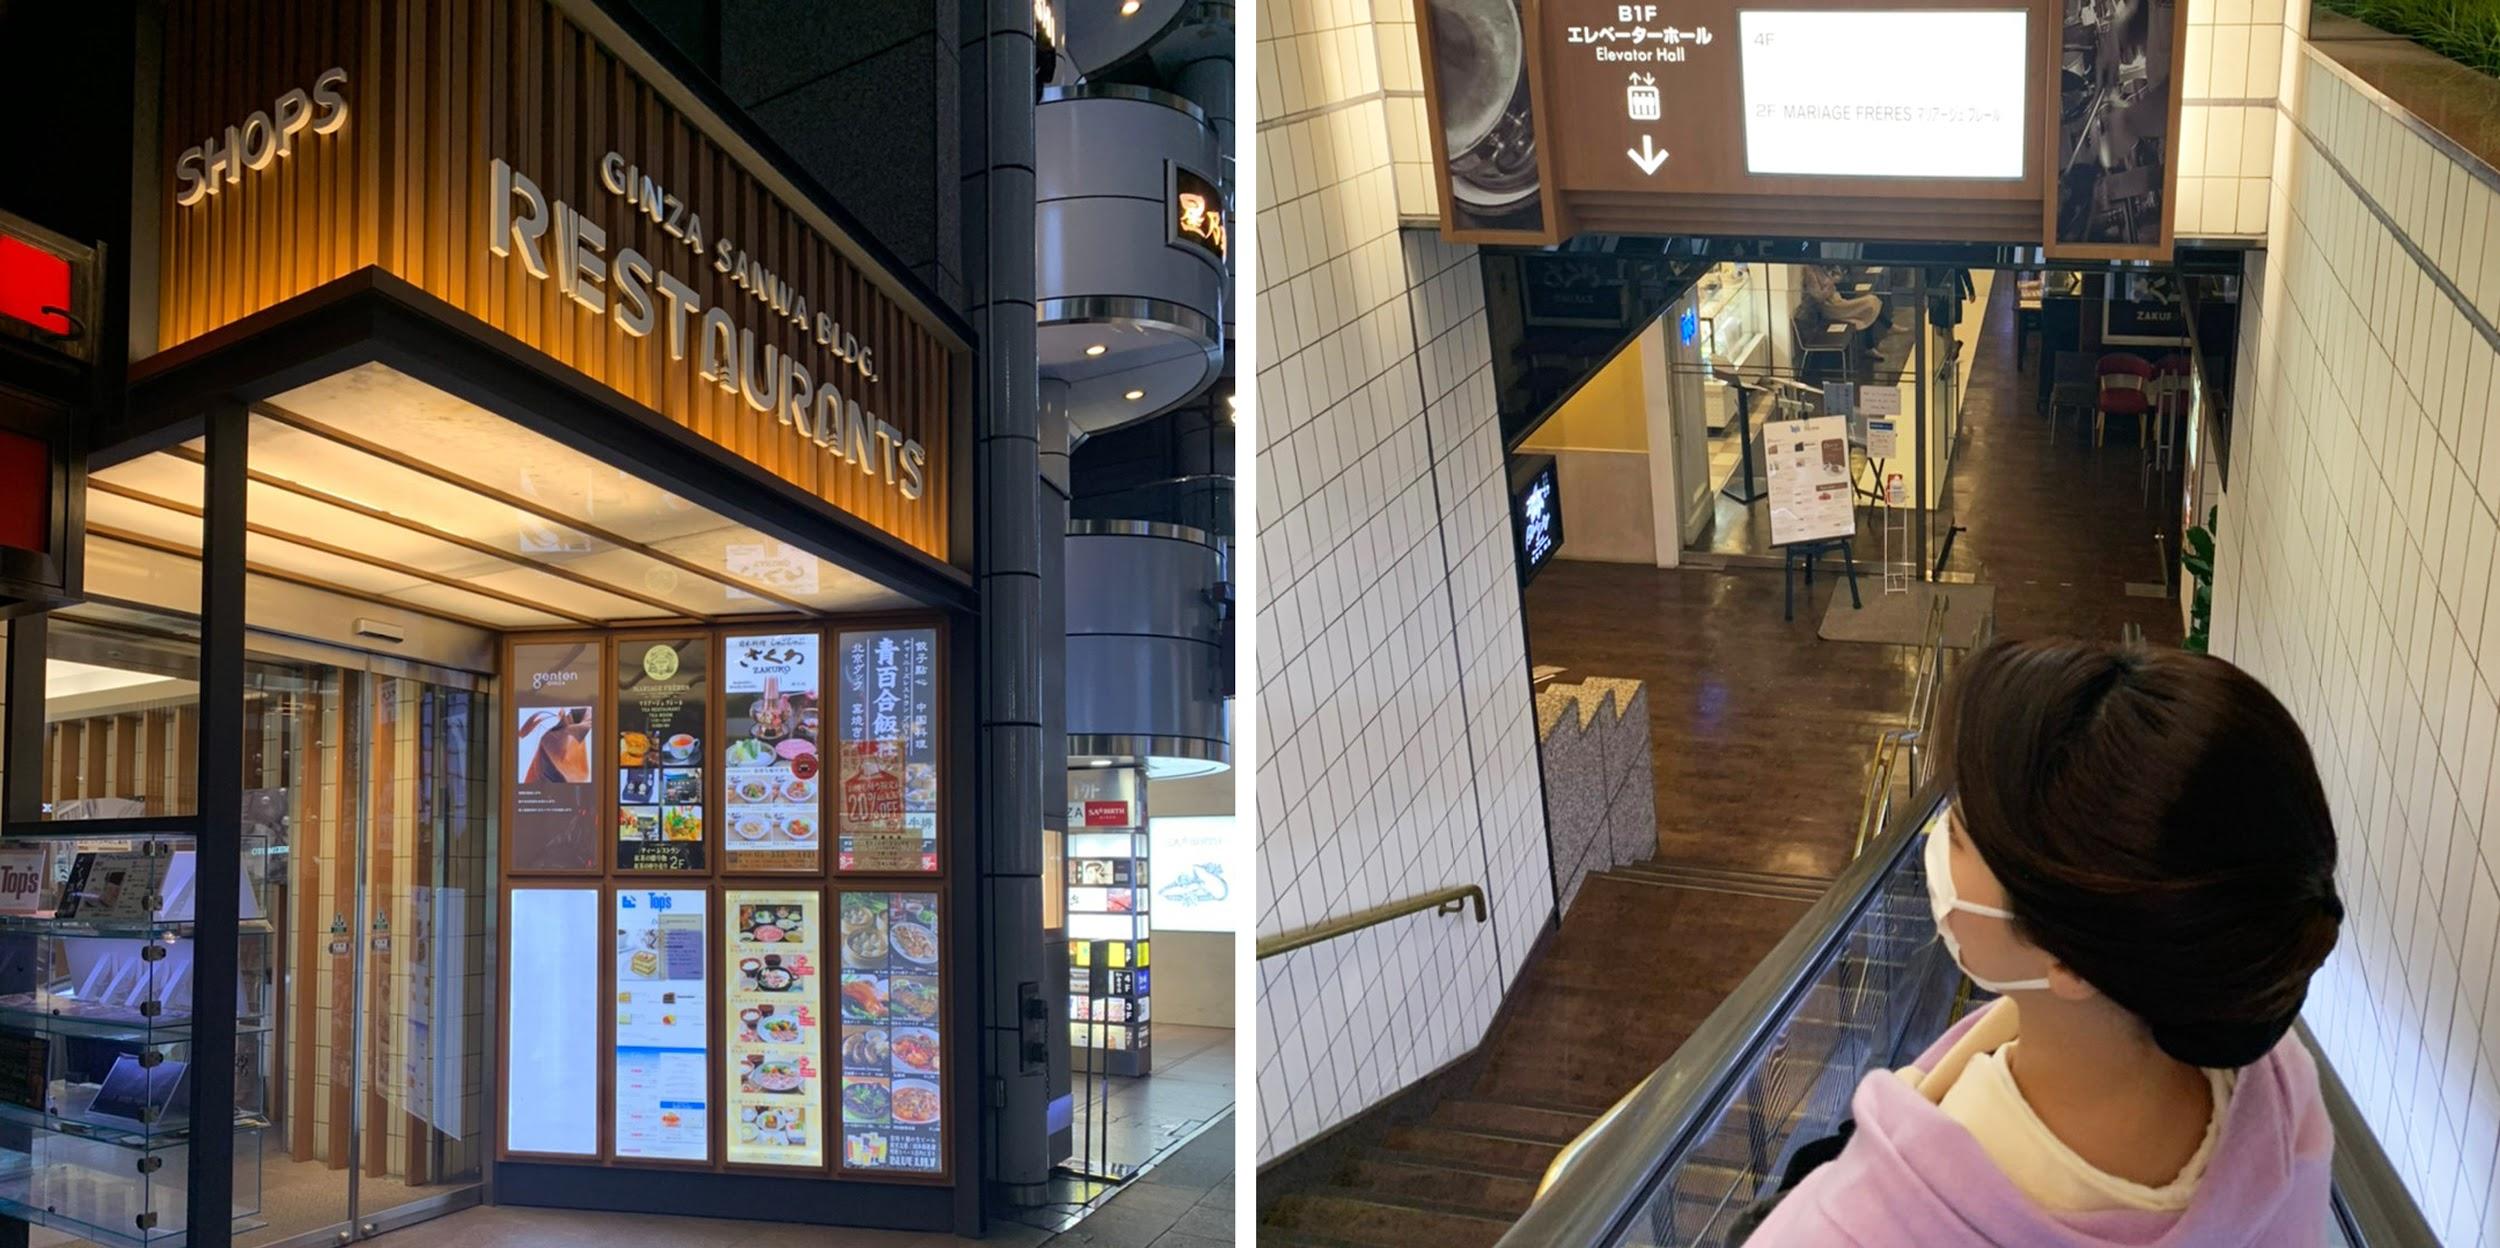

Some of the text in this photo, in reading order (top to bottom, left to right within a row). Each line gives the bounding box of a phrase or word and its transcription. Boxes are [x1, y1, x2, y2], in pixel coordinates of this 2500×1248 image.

[1618, 6, 1657, 22] B1F
[1568, 27, 1712, 45] エレベーターホール
[1753, 32, 1776, 47] 4F
[1596, 47, 1685, 62] Elevator Hall
[1755, 104, 1776, 118] 2F
[1783, 104, 1851, 121] MARIAGE
[177, 67, 348, 206] SHOPS
[601, 151, 703, 254] GINZA
[715, 237, 808, 330] SANWA
[490, 158, 925, 500] RESTAURANTS
[753, 665, 791, 675] ZAKURO
[533, 672, 578, 689] genton
[670, 856, 685, 870] 2F
